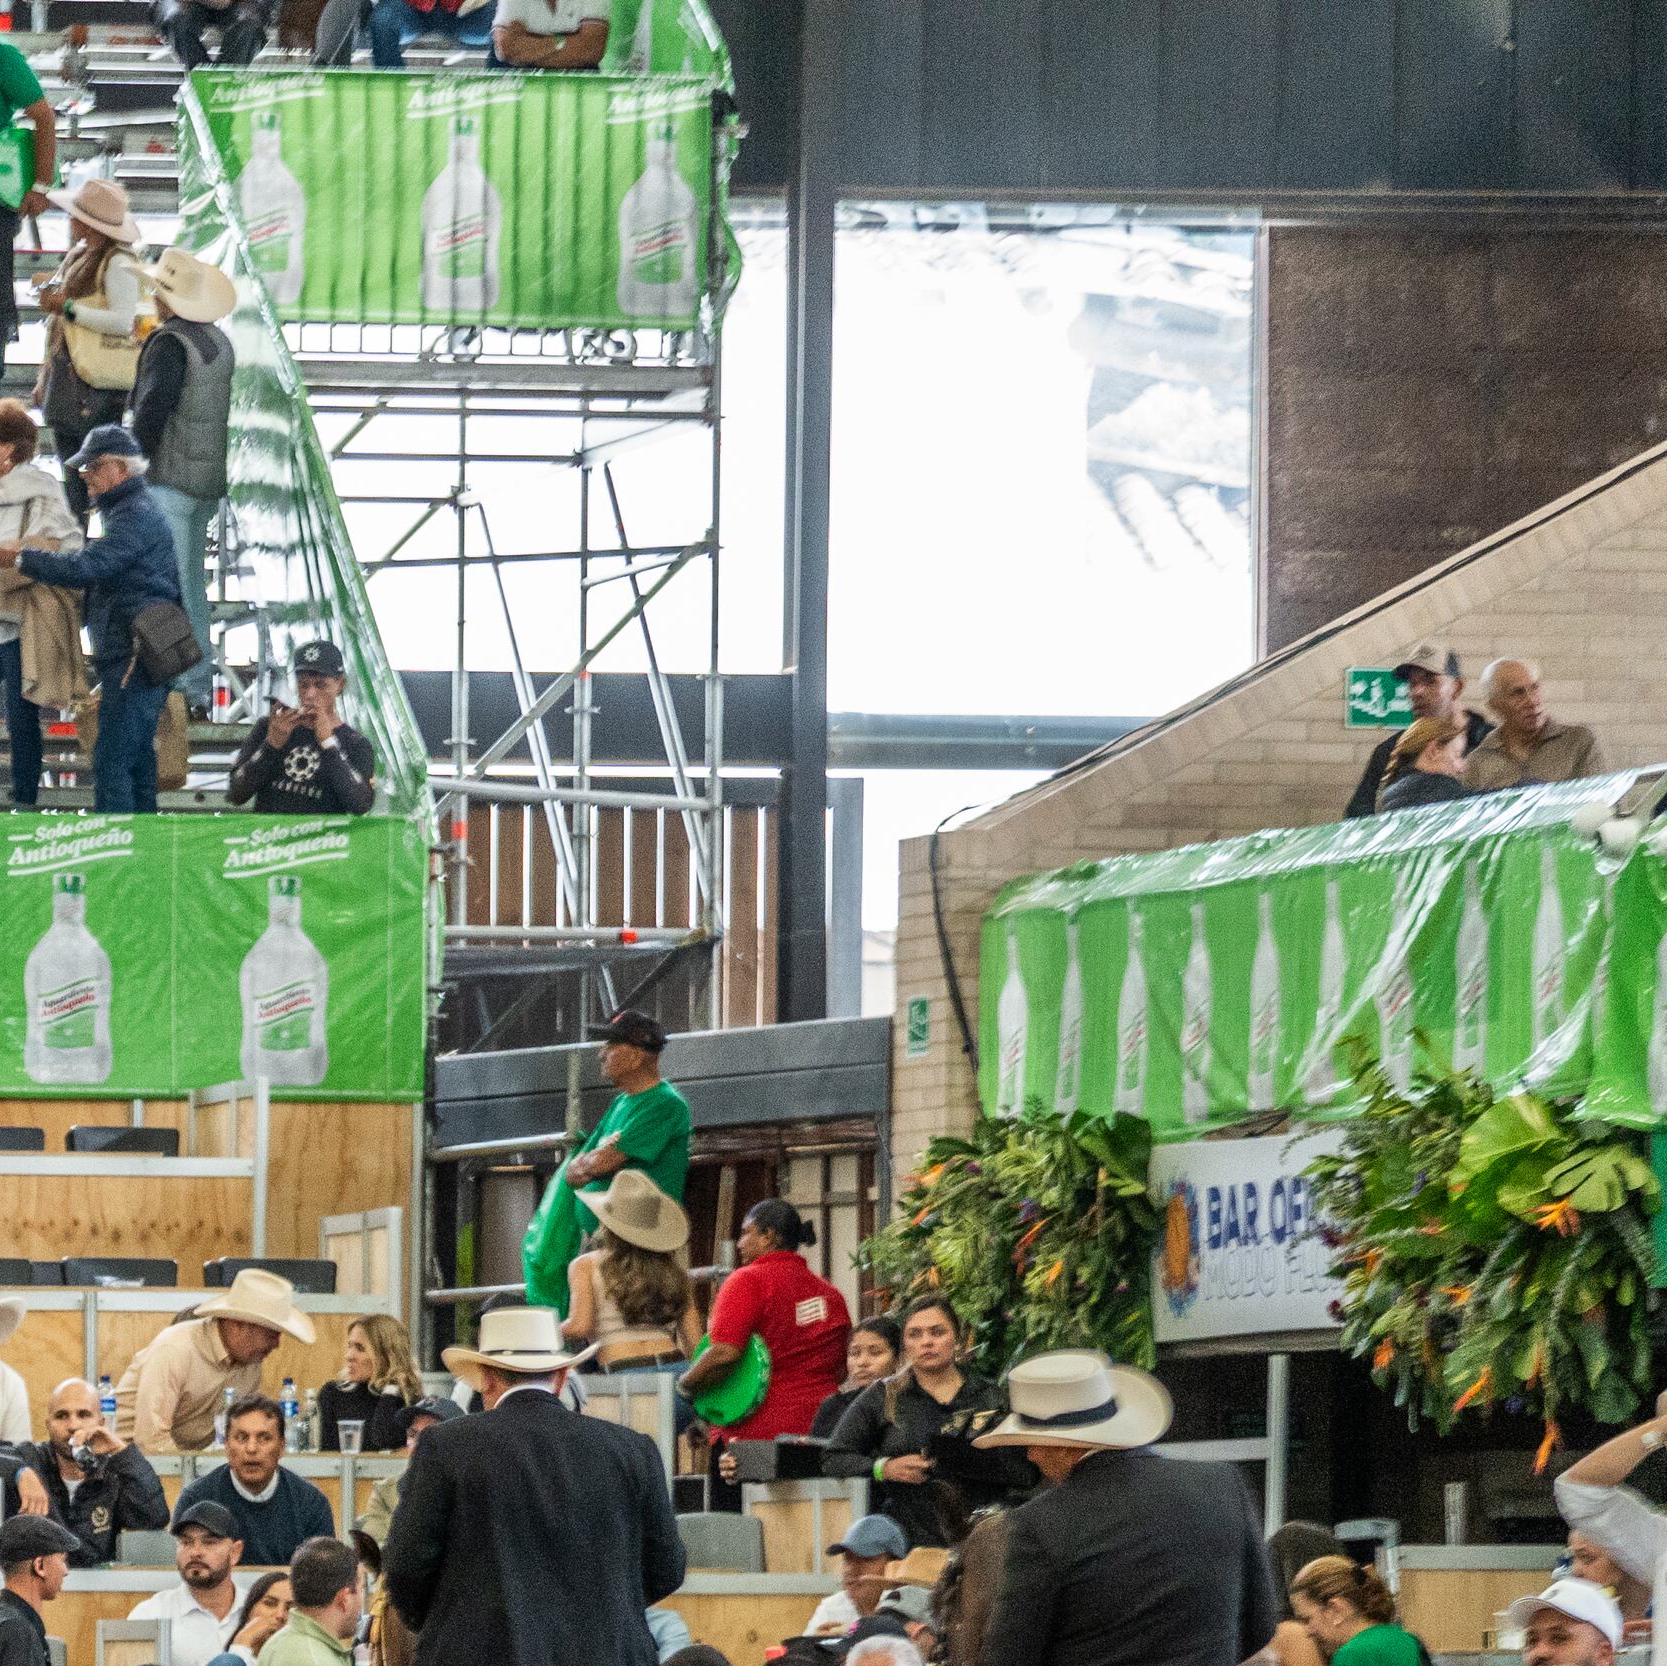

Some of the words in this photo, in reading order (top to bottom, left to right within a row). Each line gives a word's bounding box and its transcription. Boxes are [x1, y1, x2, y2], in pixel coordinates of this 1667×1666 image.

[8, 828, 133, 867] Antioqueño
[35, 822, 73, 843] Solo
[75, 817, 107, 834] con
[250, 825, 287, 847] Solo
[291, 820, 324, 838] con
[223, 832, 349, 869] Antioqueño
[1206, 1181, 1260, 1250] BAR
